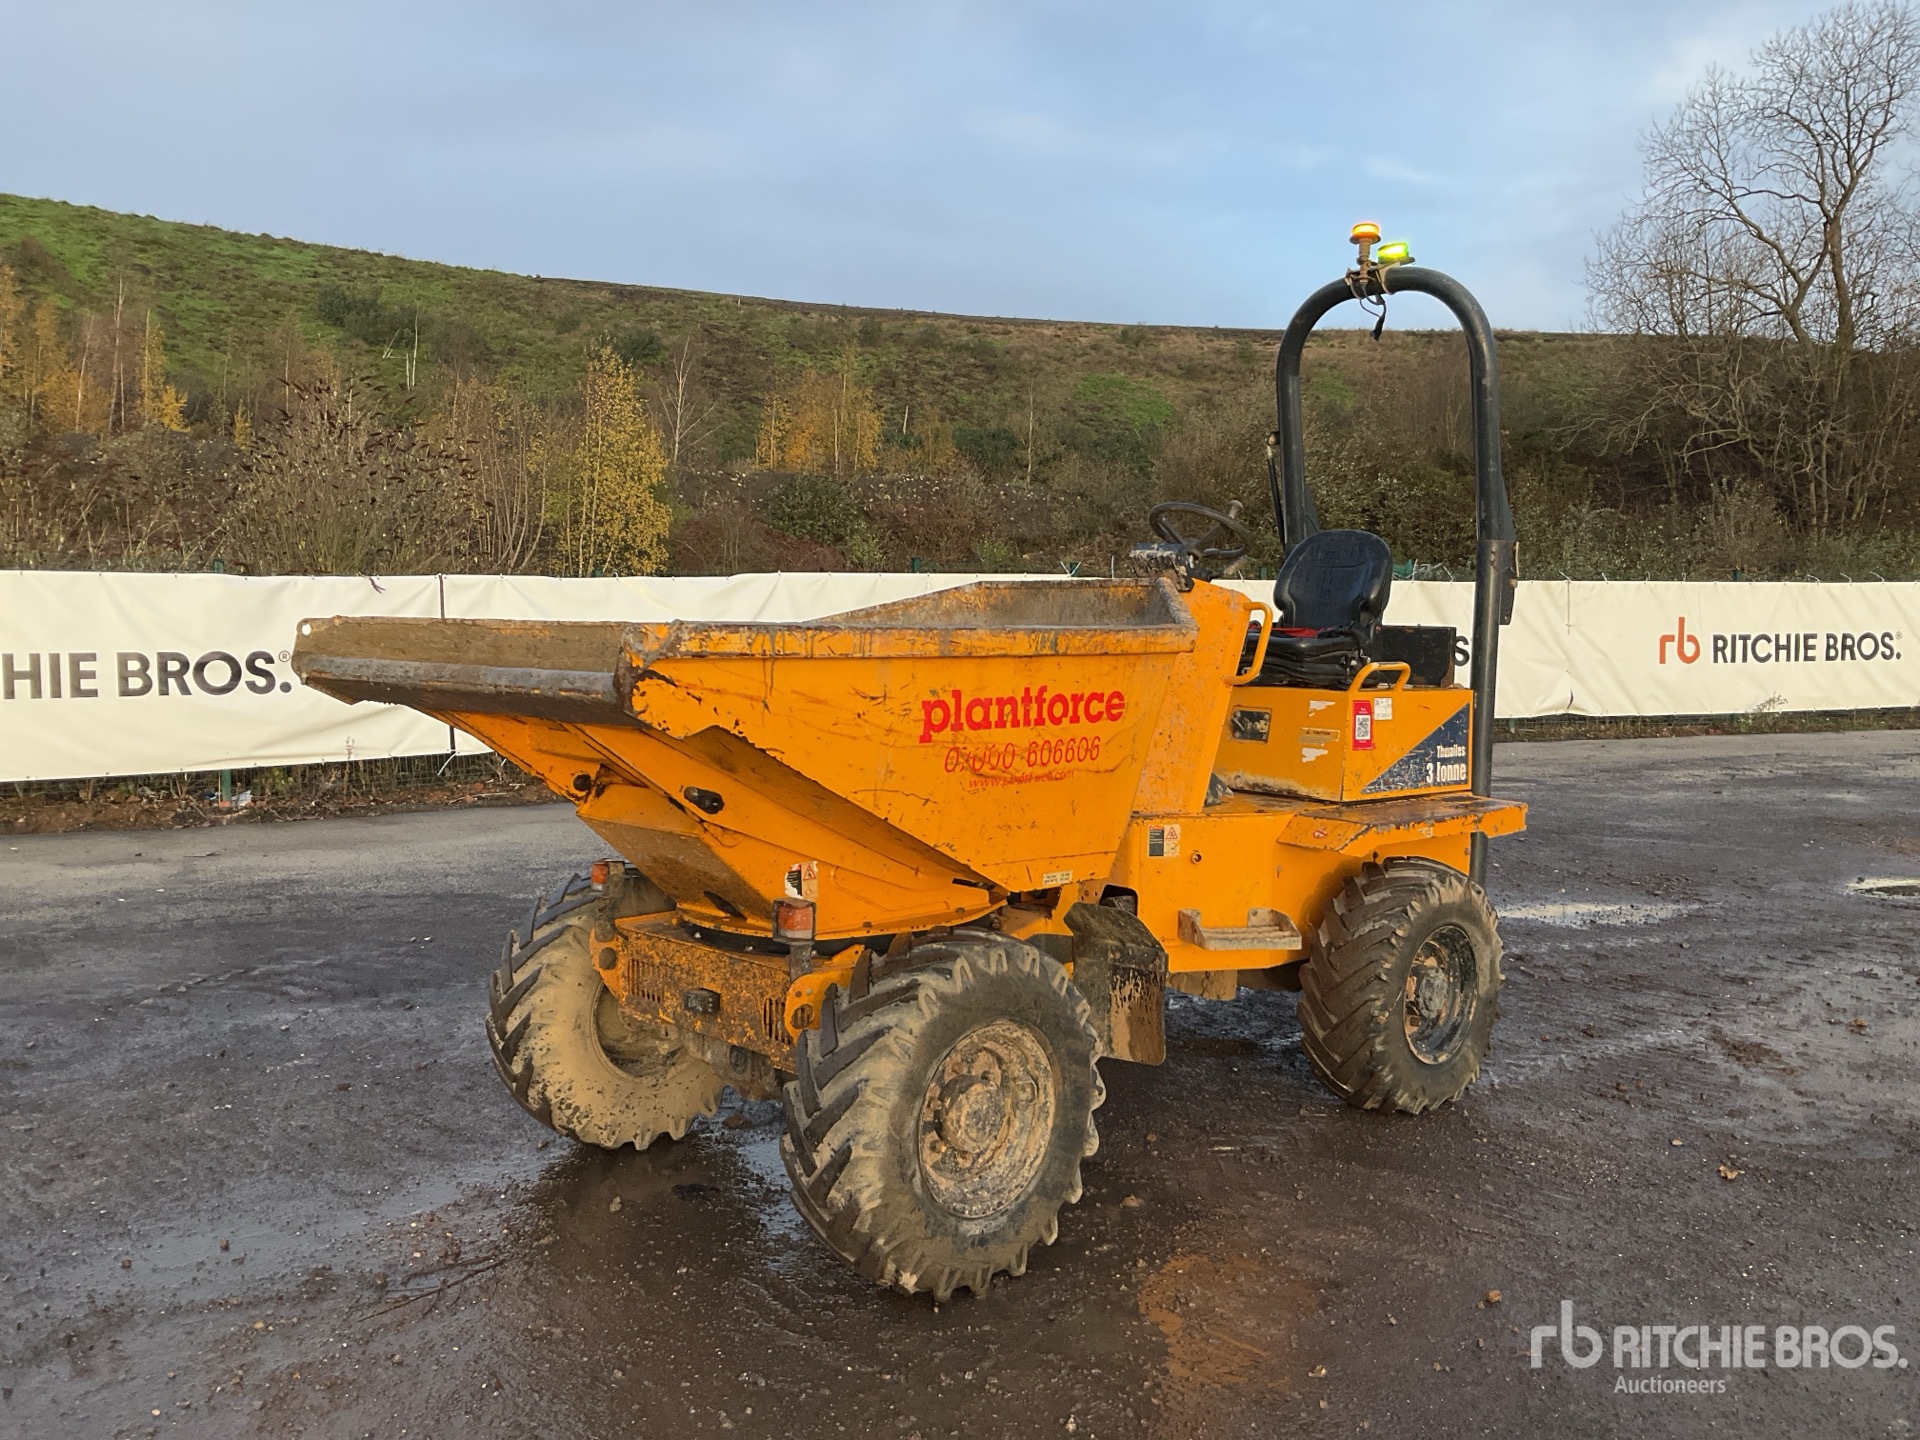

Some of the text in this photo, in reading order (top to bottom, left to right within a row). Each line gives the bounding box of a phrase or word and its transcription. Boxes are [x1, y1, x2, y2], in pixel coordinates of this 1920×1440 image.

[1712, 632, 1818, 664] RITCHIE
[918, 684, 1126, 744] plantforce
[1026, 735, 1102, 768] 606606
[1426, 762, 1434, 783] 3
